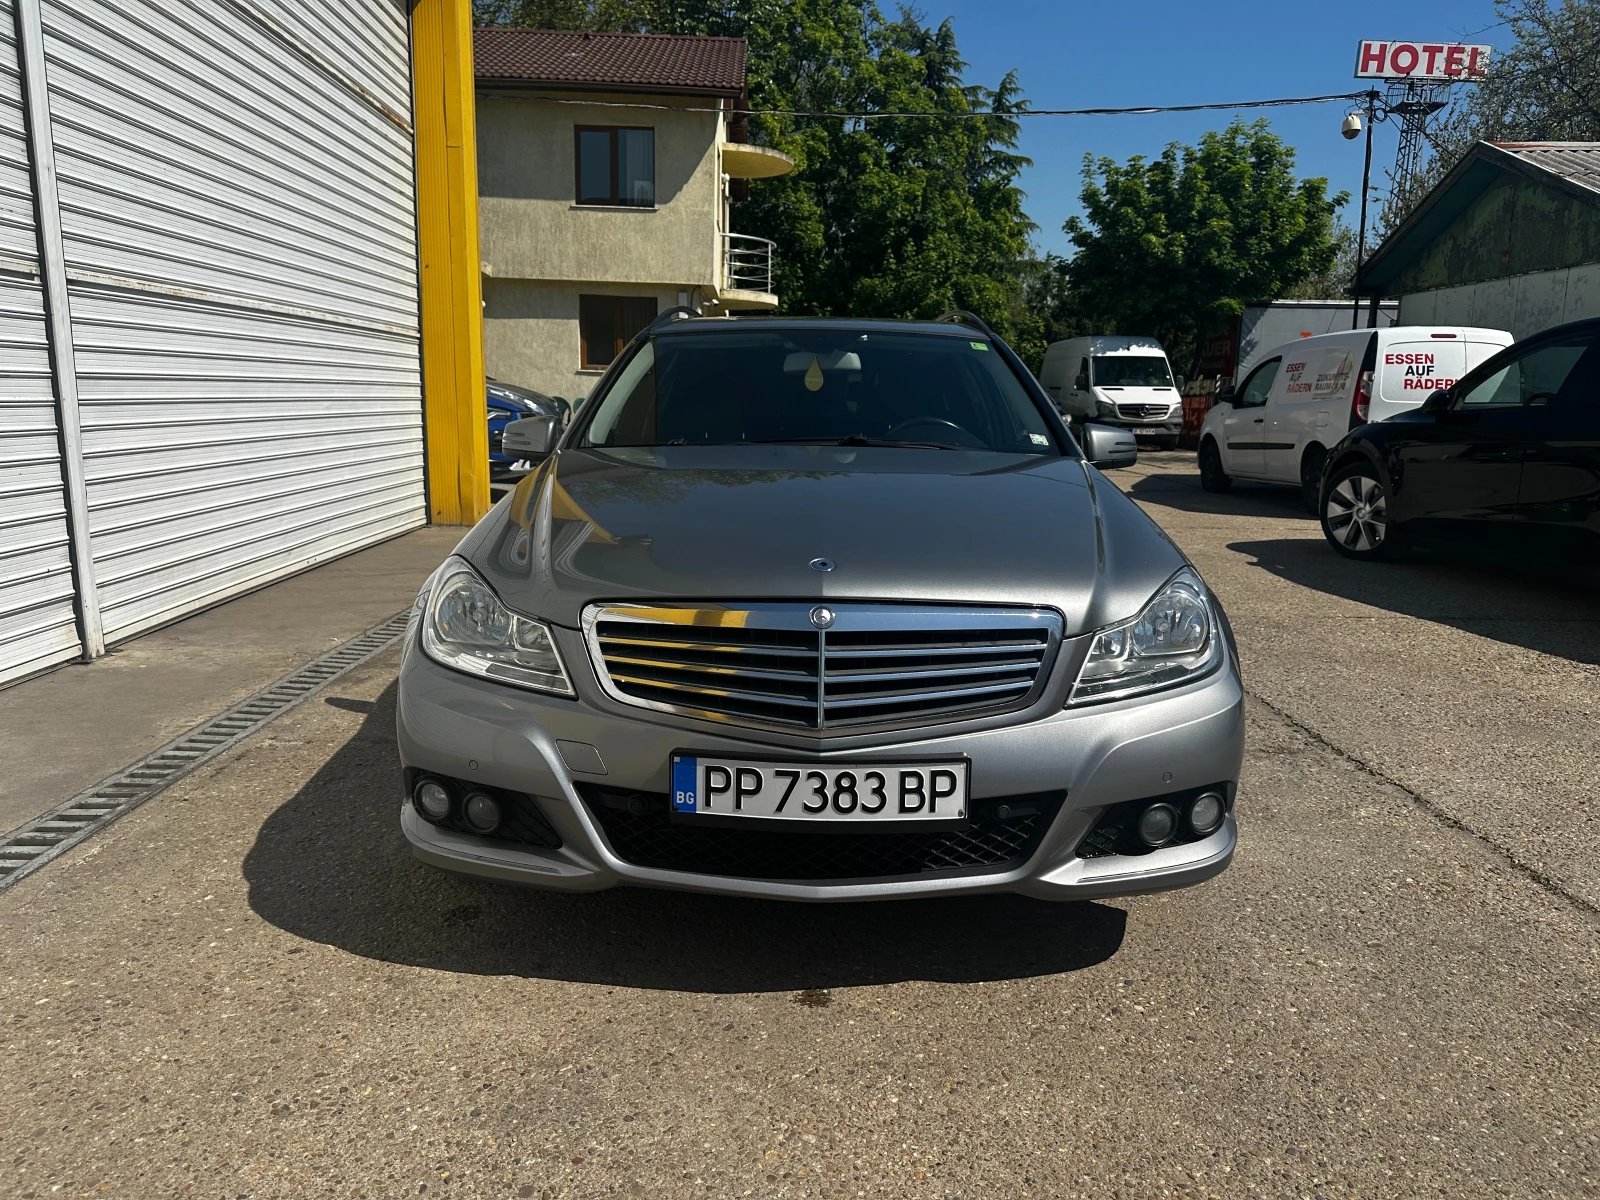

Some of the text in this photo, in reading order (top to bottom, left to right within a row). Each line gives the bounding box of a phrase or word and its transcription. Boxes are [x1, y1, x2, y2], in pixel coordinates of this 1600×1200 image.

[1360, 43, 1486, 77] HOTEL
[1385, 353, 1434, 365] ESSEN
[1286, 362, 1307, 373] ESSEN
[1404, 365, 1434, 376] AUF
[1289, 372, 1303, 382] AUF
[1286, 382, 1313, 393] RÄDERN
[704, 765, 957, 814] PP 7383 BP
[676, 792, 695, 805] BG
